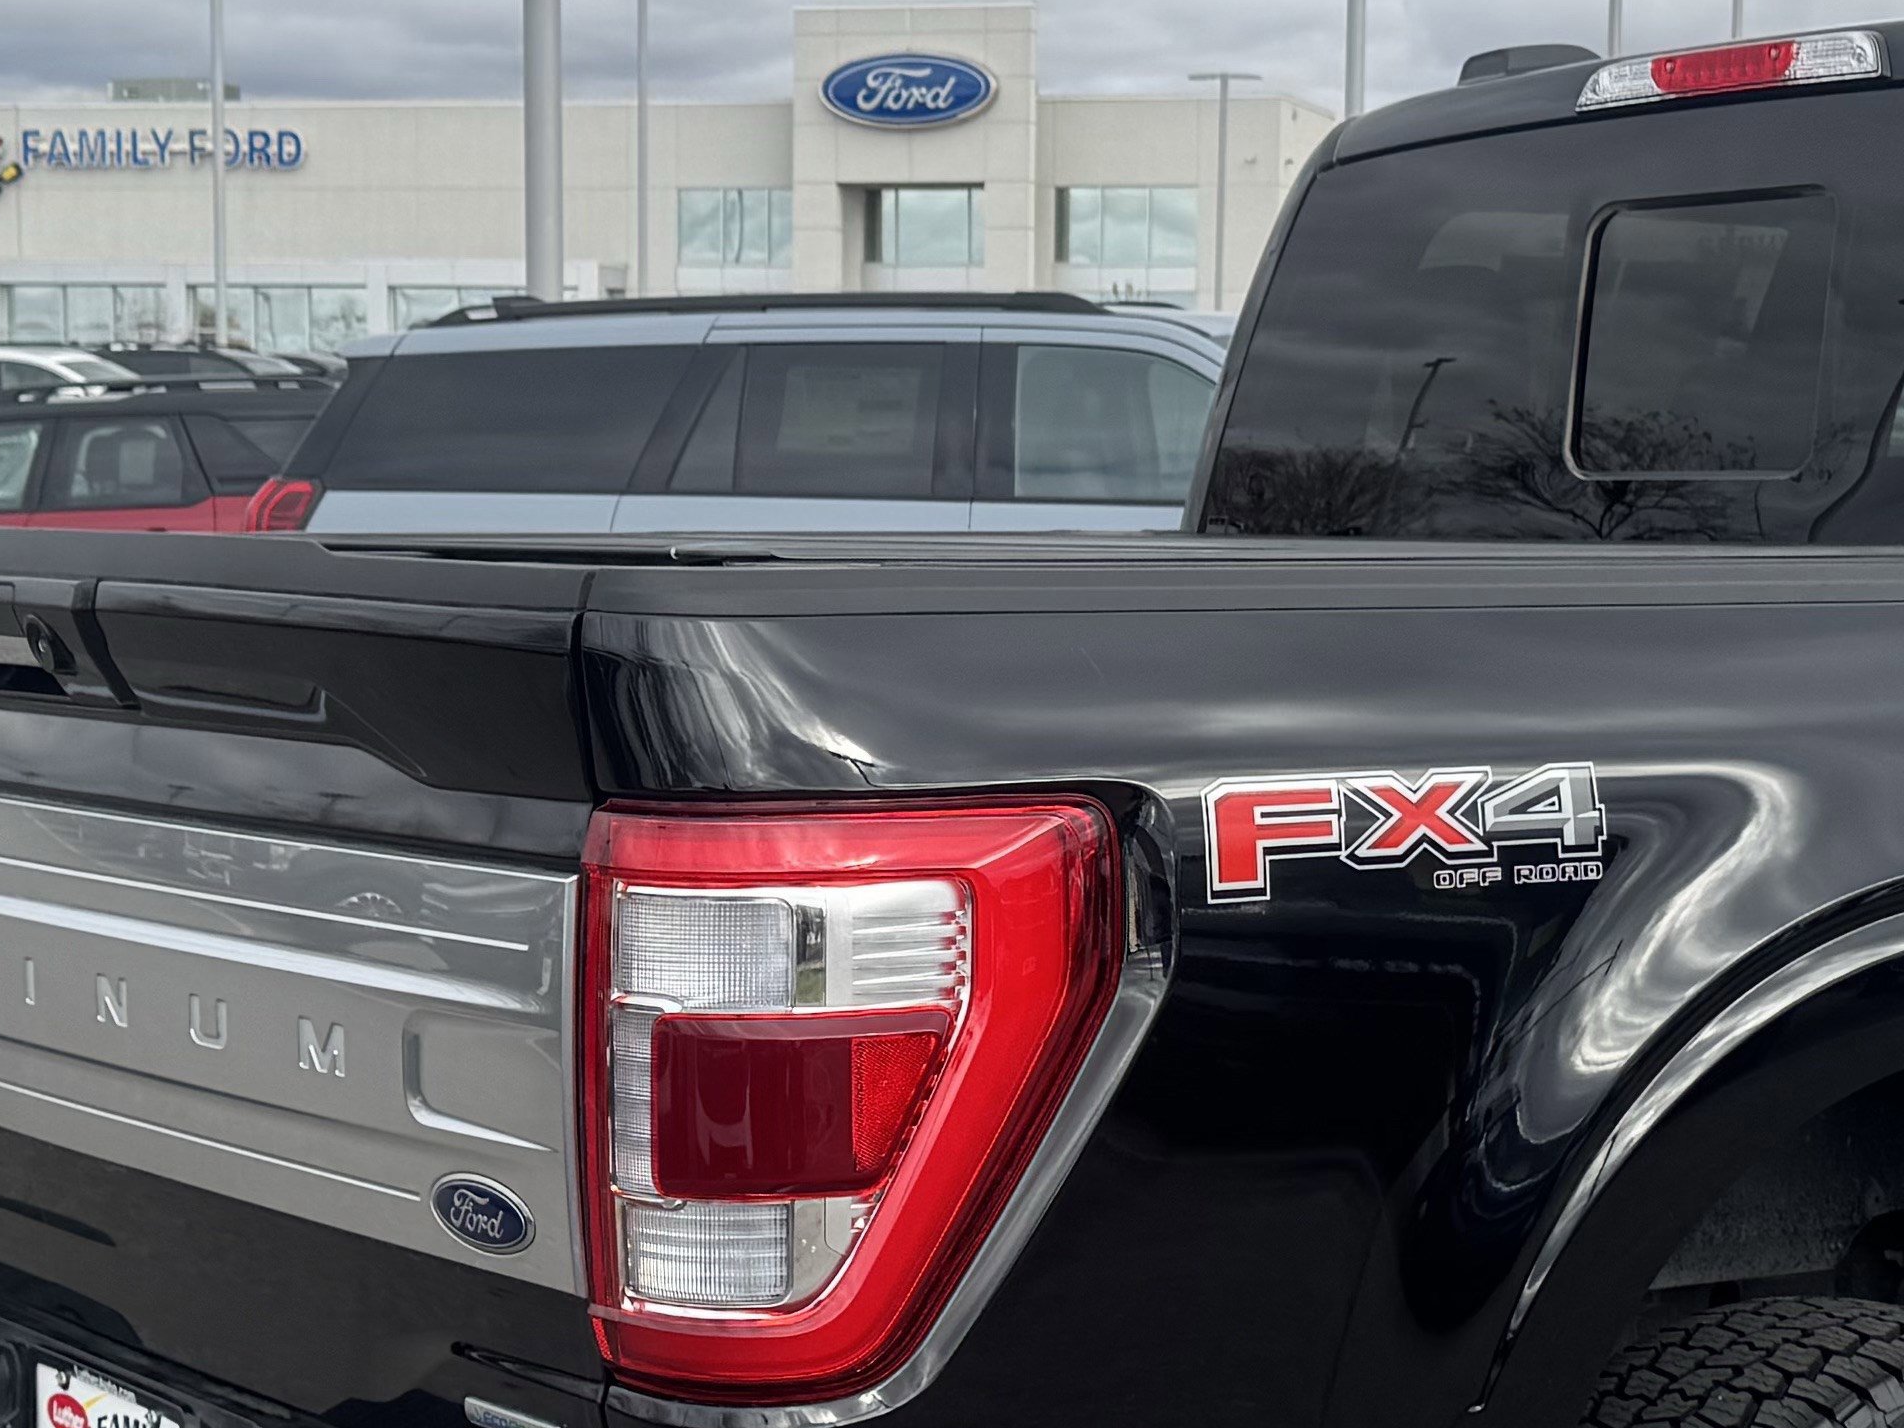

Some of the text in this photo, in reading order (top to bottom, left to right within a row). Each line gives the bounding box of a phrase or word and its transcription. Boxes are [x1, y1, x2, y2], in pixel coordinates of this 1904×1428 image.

[856, 66, 956, 112] Ford
[21, 127, 304, 169] FAMILY FORD
[1200, 761, 1607, 905] FX4
[1433, 861, 1603, 889] OFF ROAD
[450, 1188, 504, 1239] Ford
